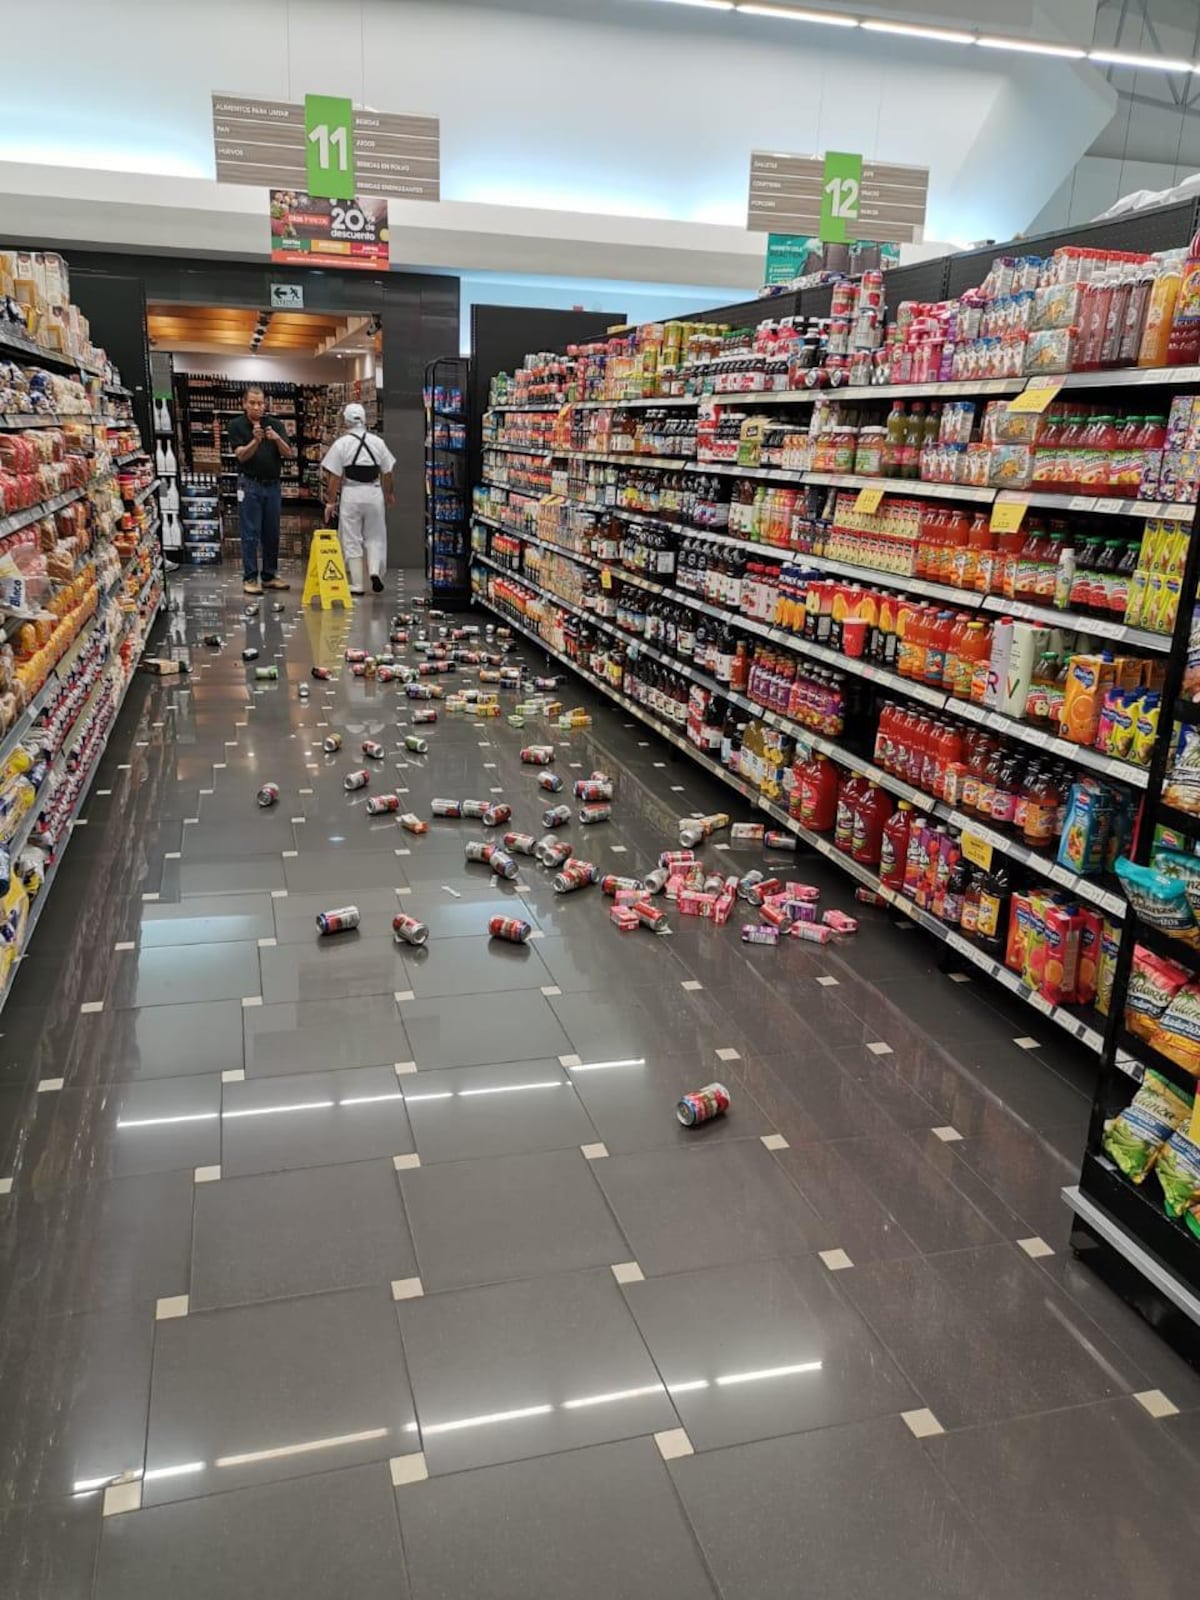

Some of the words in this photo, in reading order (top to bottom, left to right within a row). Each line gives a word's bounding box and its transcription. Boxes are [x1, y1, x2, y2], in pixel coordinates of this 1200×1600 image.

[308, 124, 348, 171] 11
[825, 177, 858, 219] 12
[330, 229, 376, 241] descuento
